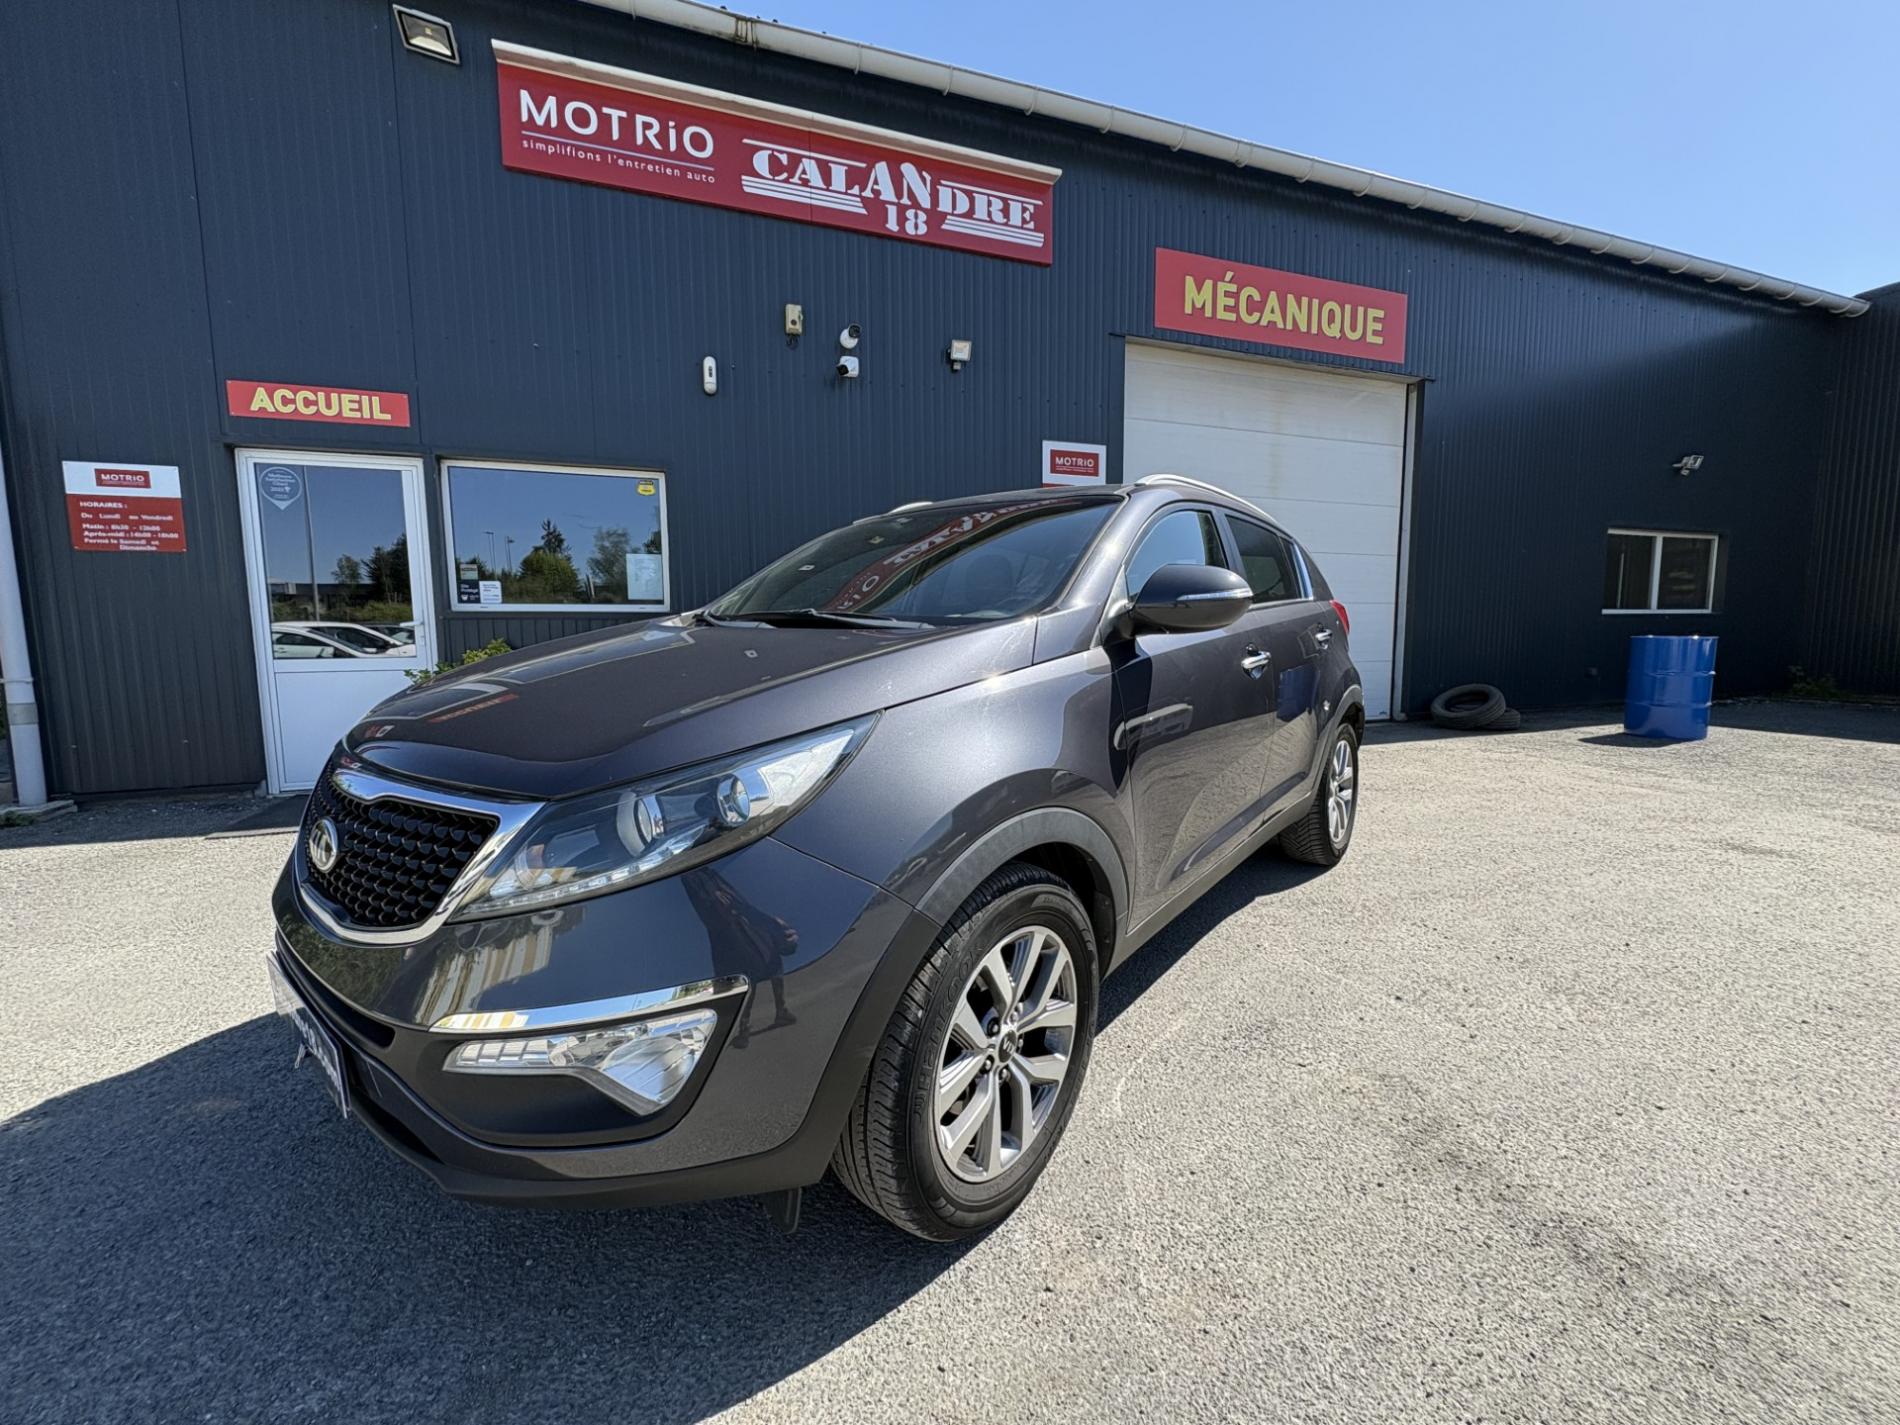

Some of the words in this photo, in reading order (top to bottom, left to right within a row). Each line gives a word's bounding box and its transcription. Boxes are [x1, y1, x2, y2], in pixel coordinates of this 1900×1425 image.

[522, 139, 601, 162] simplifions
[608, 154, 680, 177] l'entretien
[687, 172, 715, 184] auto
[752, 149, 1035, 230] CALANDRE
[885, 204, 928, 235] 18
[1184, 271, 1385, 345] MÉCANIQUE
[250, 387, 392, 421] ACCUEIL
